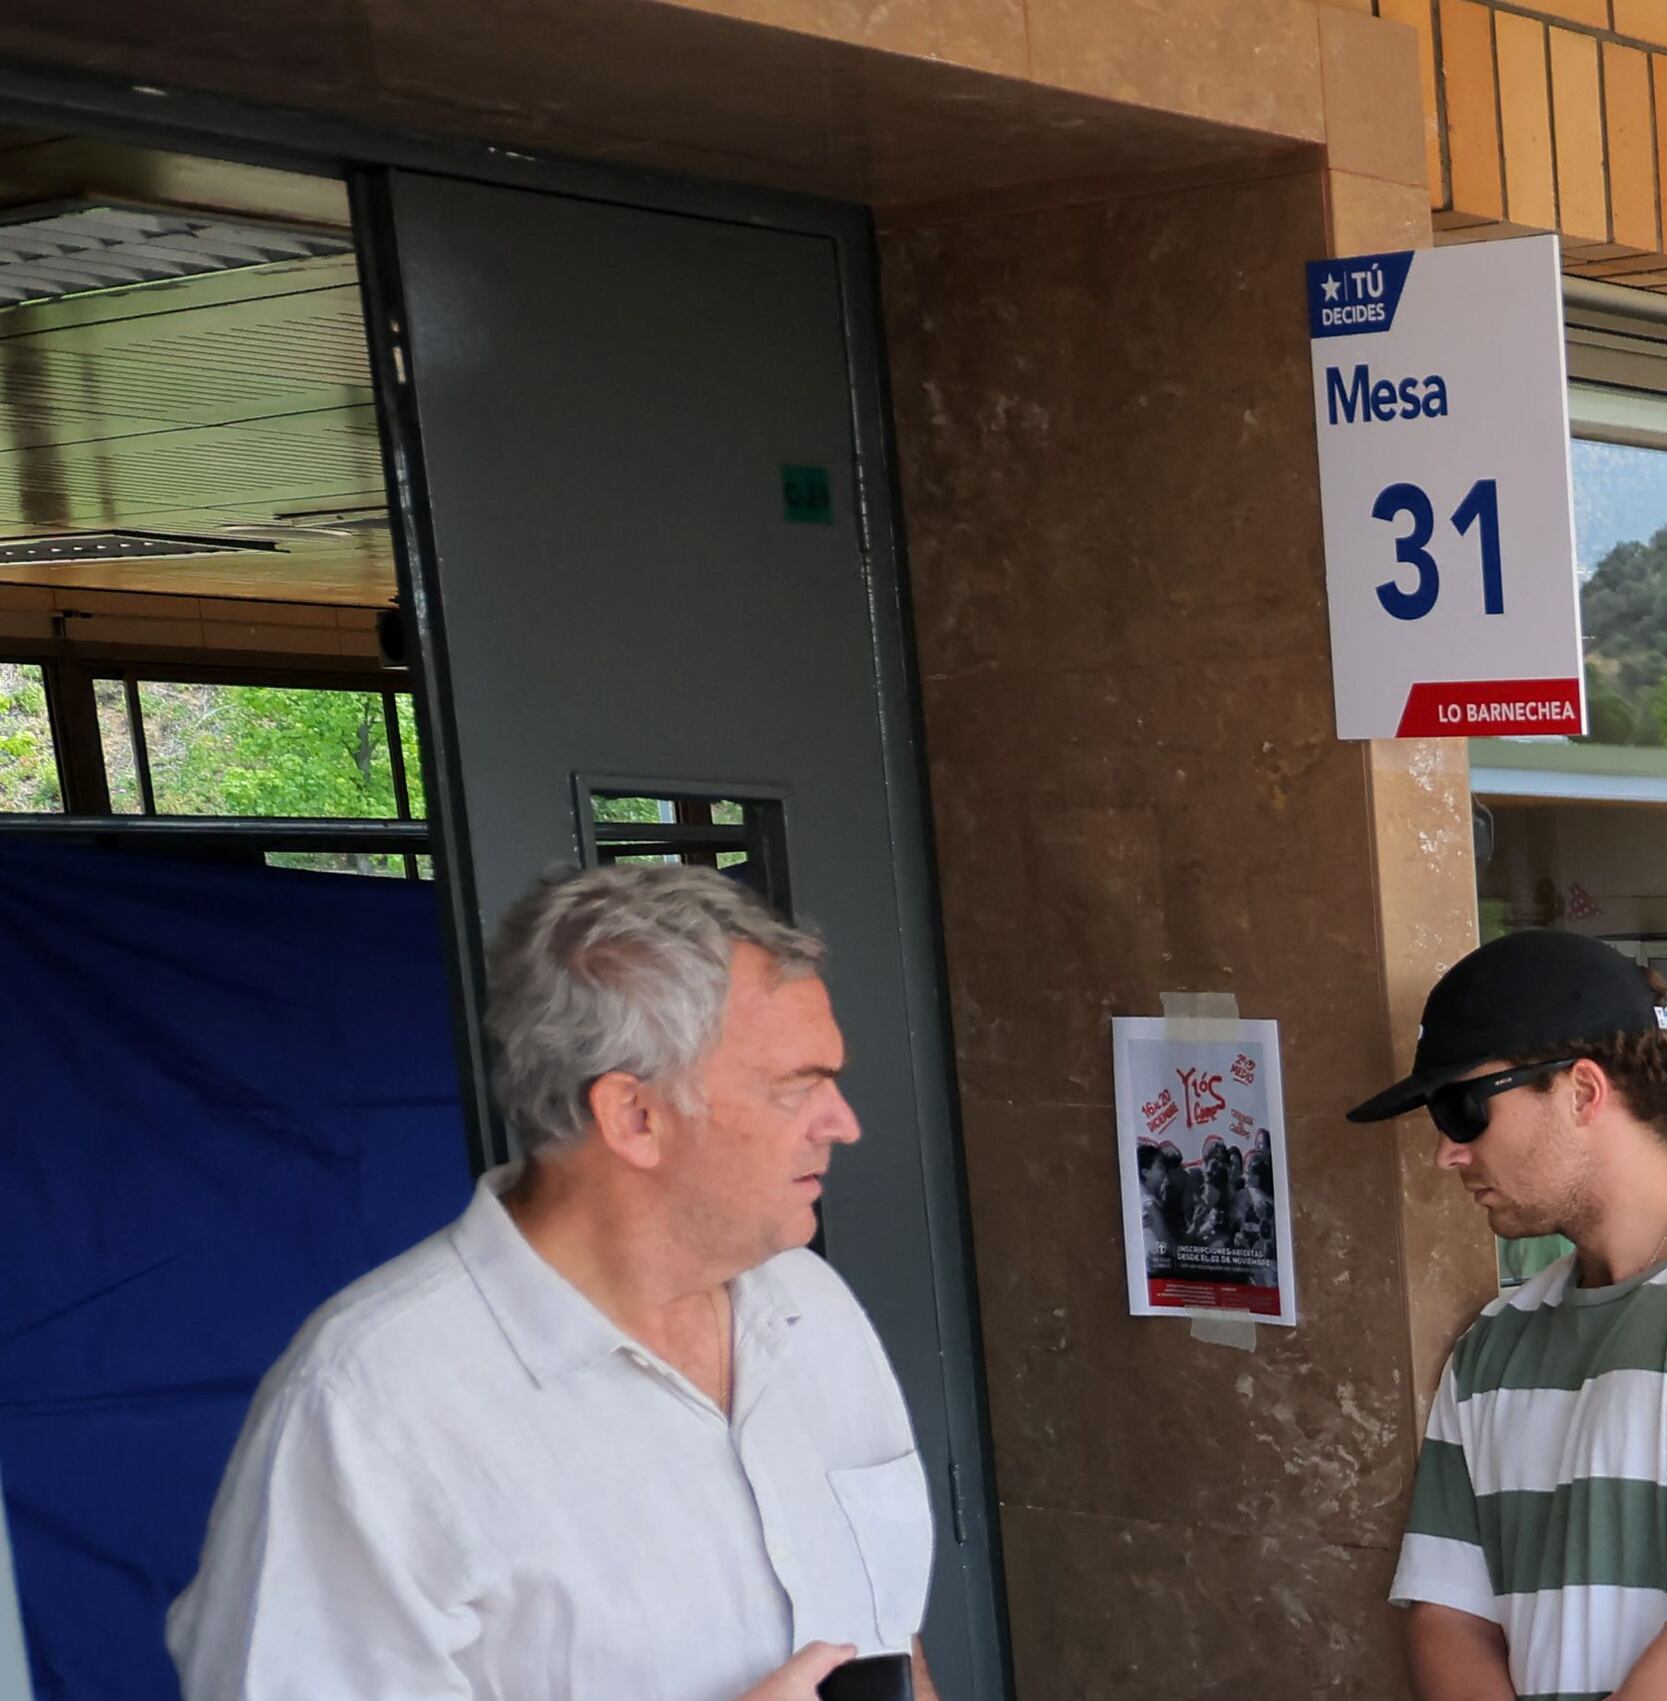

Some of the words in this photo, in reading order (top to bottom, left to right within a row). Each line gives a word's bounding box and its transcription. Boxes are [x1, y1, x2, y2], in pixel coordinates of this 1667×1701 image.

[1351, 262, 1384, 298] TÚ
[1321, 302, 1385, 326] DECIDES
[1325, 363, 1449, 425] Mesa
[1371, 478, 1504, 620] 31
[1437, 704, 1461, 723] LO
[1466, 701, 1575, 722] BARNECHEA
